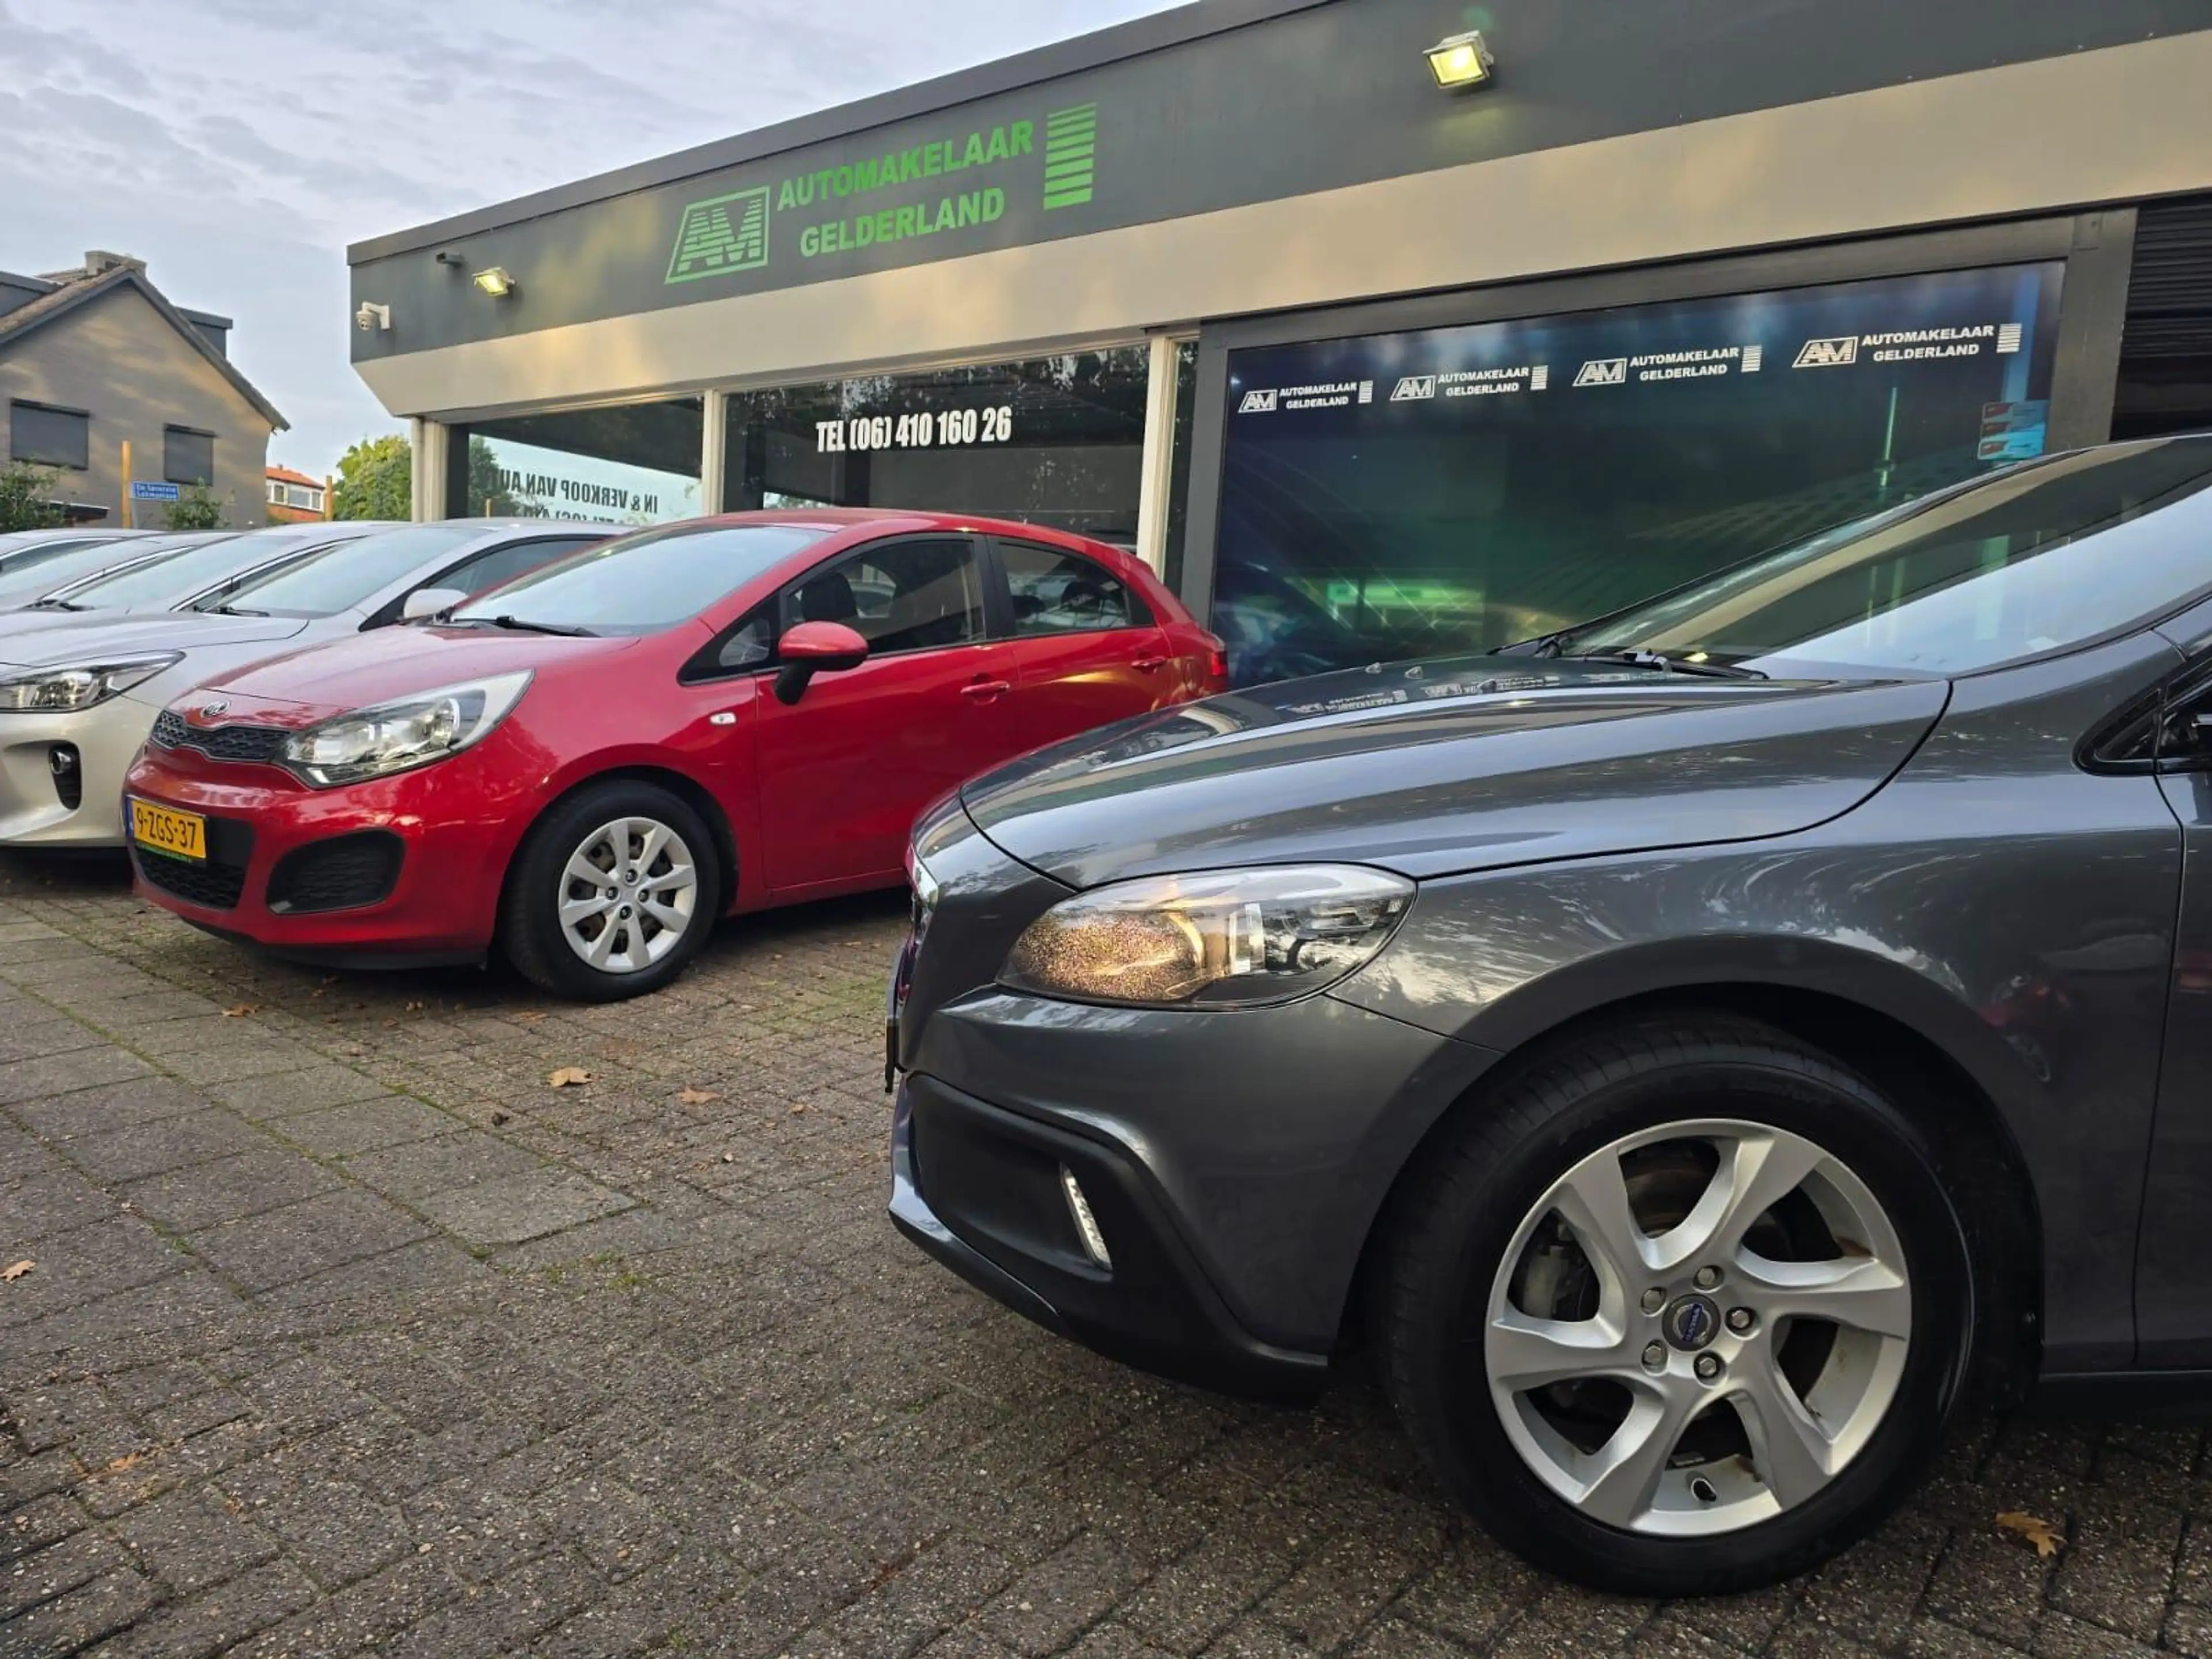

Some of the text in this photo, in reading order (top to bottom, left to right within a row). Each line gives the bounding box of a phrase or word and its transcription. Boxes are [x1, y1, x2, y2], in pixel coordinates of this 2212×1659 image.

[777, 119, 1034, 211] AUTOMAKELAAR
[800, 187, 1005, 258] GELDERLAND
[1861, 324, 1995, 346] AUTOMAKELAAR
[1629, 347, 1740, 367] AUTOMAKELAAR
[1800, 341, 1852, 363] AM
[1872, 344, 1980, 362] GELDERLAND
[1437, 367, 1529, 384] AUTOMAKELAAR
[1578, 362, 1623, 384] AM
[1639, 364, 1728, 381] GELDERLAND
[1279, 382, 1357, 397] AUTOMAKELAAR
[1396, 379, 1431, 397] AM
[1445, 382, 1520, 397] GELDERLAND
[1243, 392, 1274, 410] AM
[1285, 396, 1349, 410] GELDERLAND
[816, 405, 1012, 453] TEL (06) 410 160 26
[137, 807, 196, 851] 9-ZGS-37
